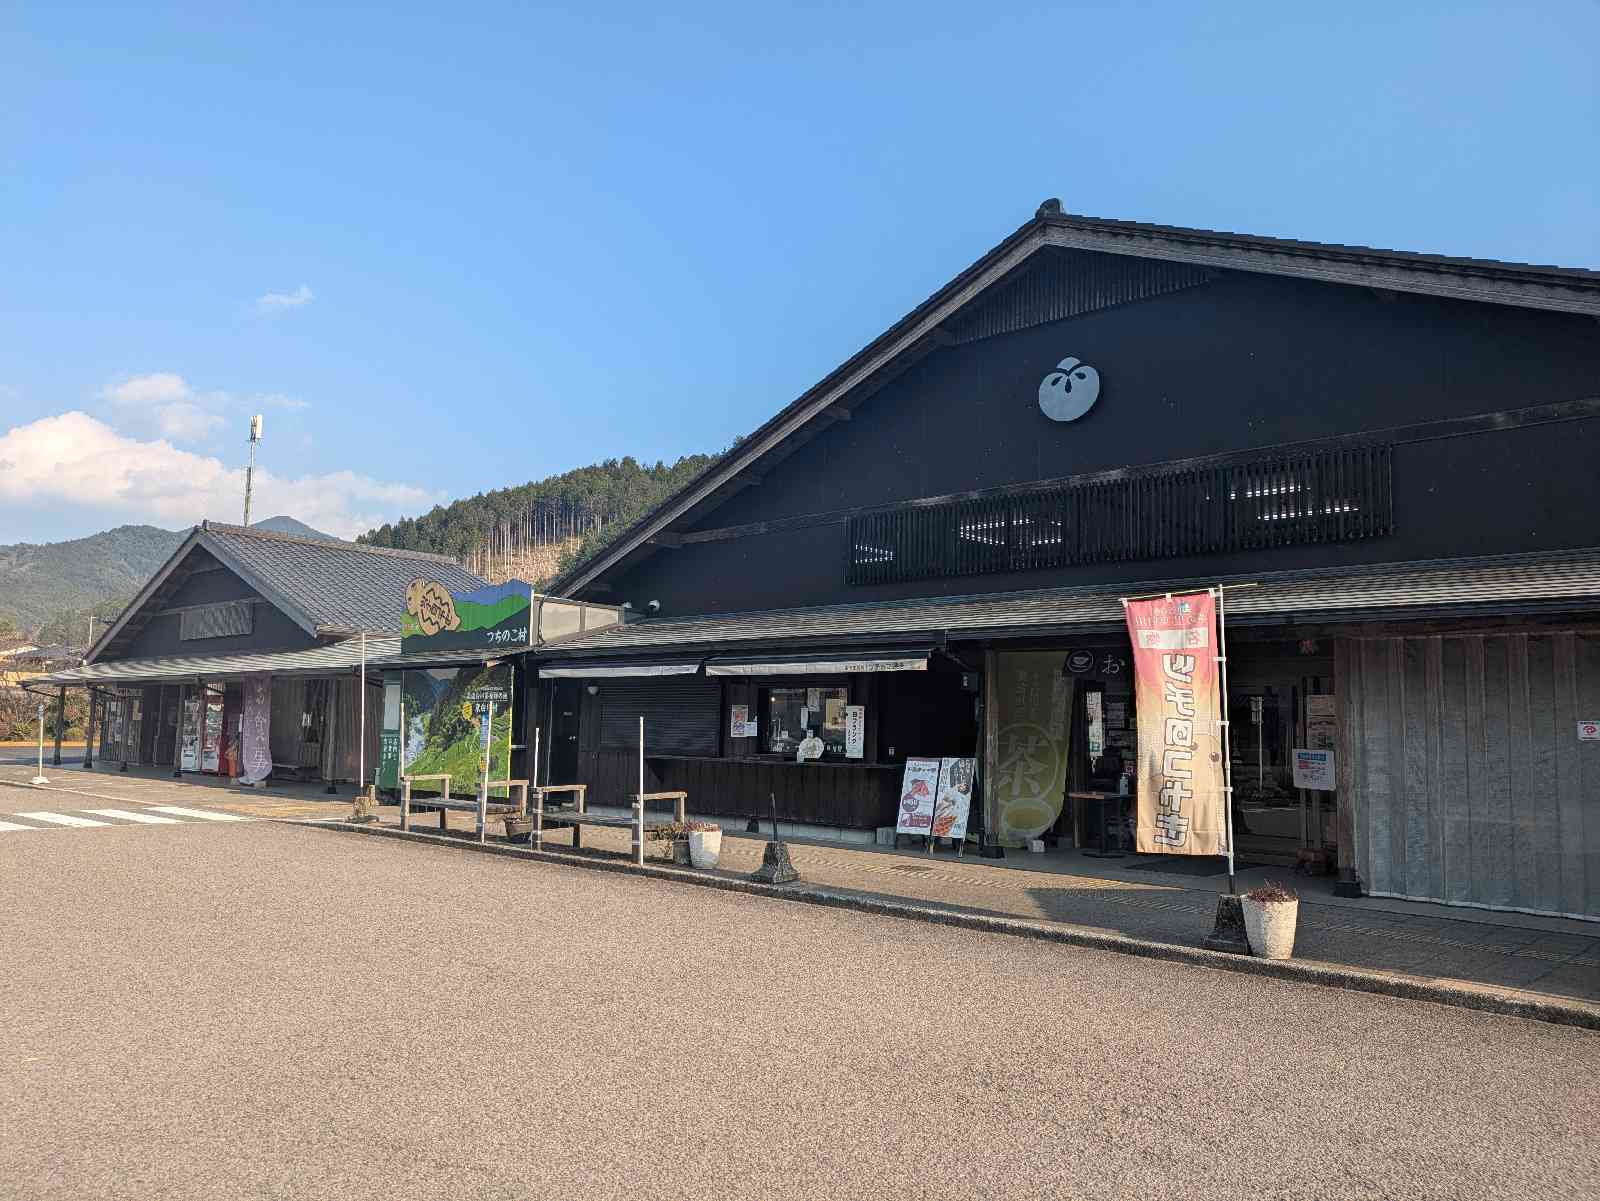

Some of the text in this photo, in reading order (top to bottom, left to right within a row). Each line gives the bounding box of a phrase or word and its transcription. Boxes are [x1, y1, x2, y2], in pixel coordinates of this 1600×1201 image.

[487, 627, 527, 643] つちのこ村
[1102, 654, 1125, 674] お
[998, 735, 1049, 797] 茶
